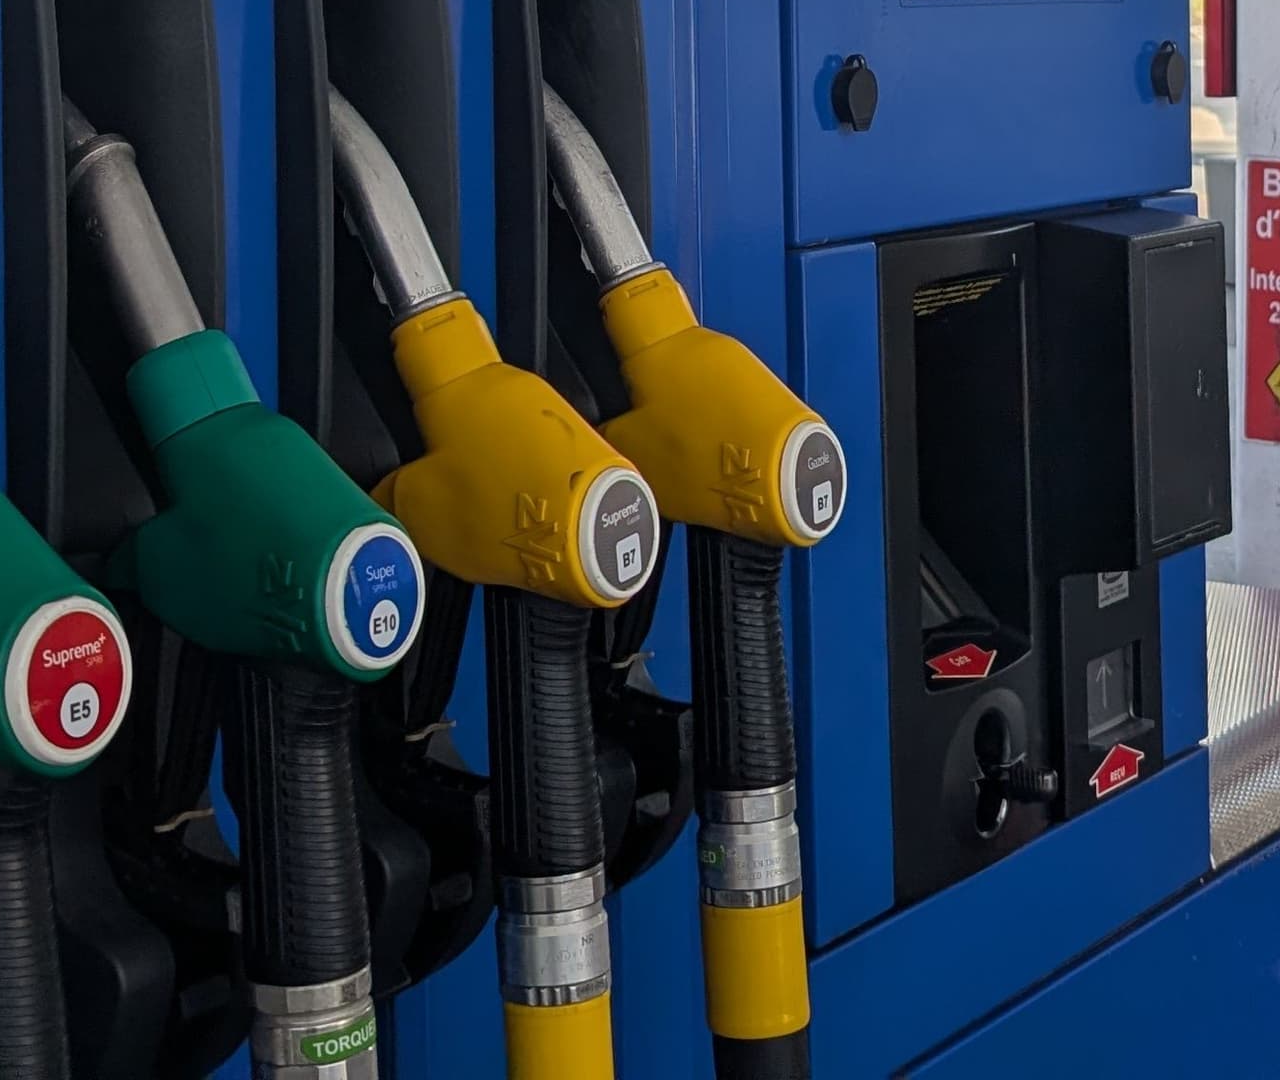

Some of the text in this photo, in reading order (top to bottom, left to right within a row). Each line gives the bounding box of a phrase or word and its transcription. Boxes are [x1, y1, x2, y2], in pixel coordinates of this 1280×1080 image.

[807, 451, 830, 470] Gazole
[817, 494, 829, 511] B7
[622, 548, 636, 568] B7
[366, 564, 396, 582] Super
[373, 613, 396, 636] E10
[70, 699, 91, 723] E5
